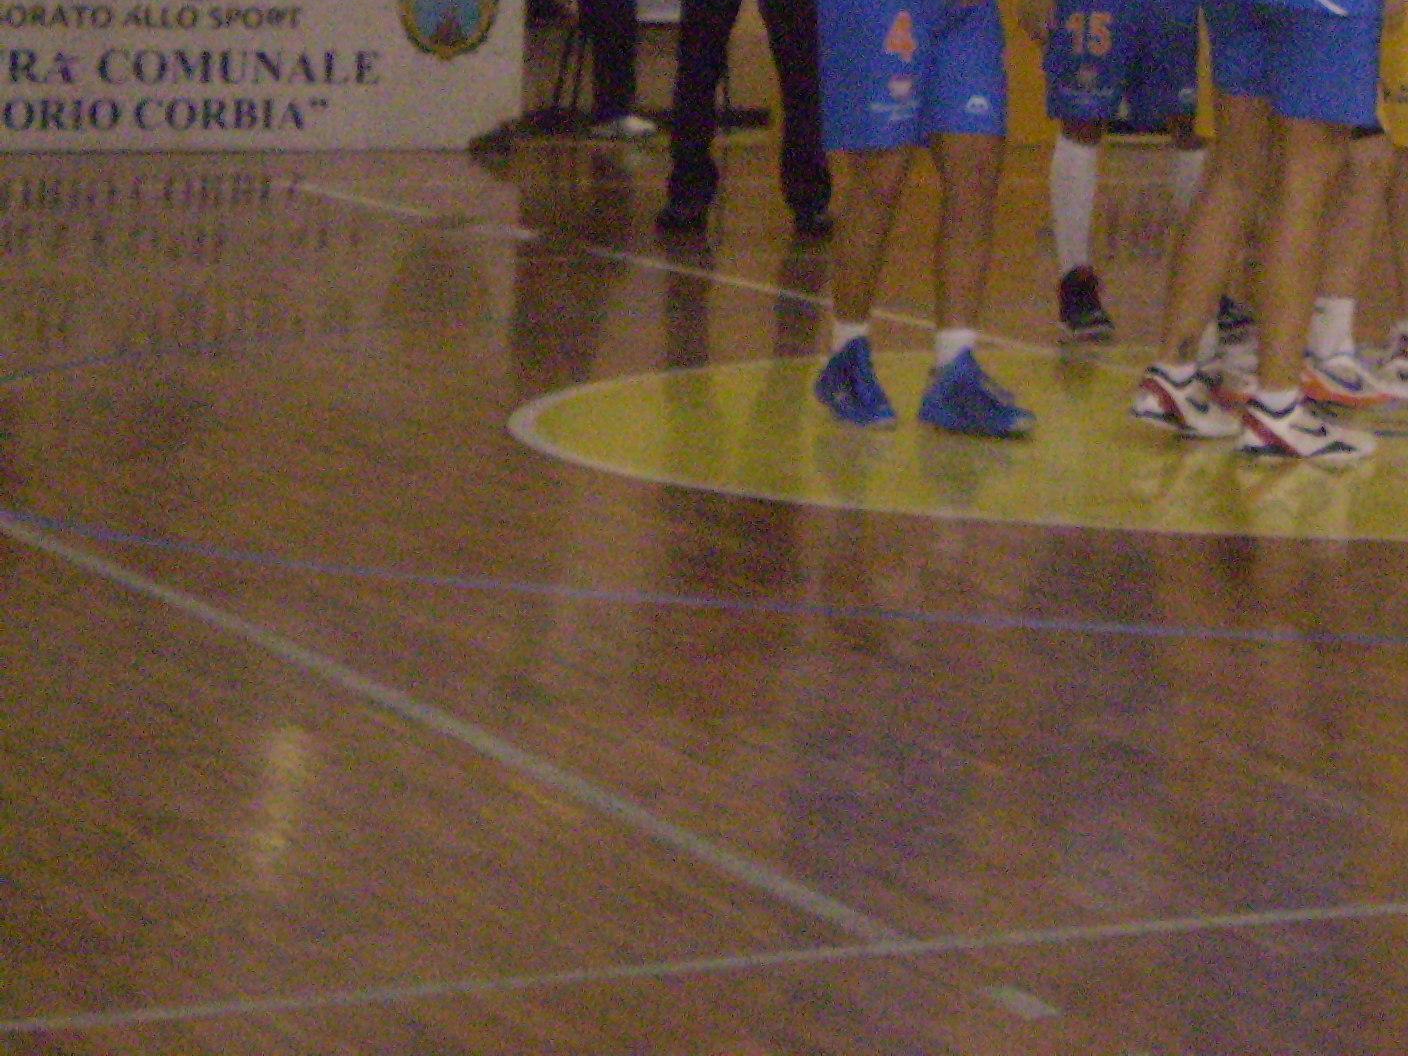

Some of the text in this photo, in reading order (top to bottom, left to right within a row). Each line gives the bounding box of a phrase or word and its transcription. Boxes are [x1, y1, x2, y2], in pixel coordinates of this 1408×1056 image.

[0, 3, 302, 31] ORATO ALLO SPORT
[884, 9, 919, 63] 4
[1065, 11, 1113, 58] 15
[0, 47, 380, 86] RA COMUNALE
[2, 97, 123, 133] ORIO
